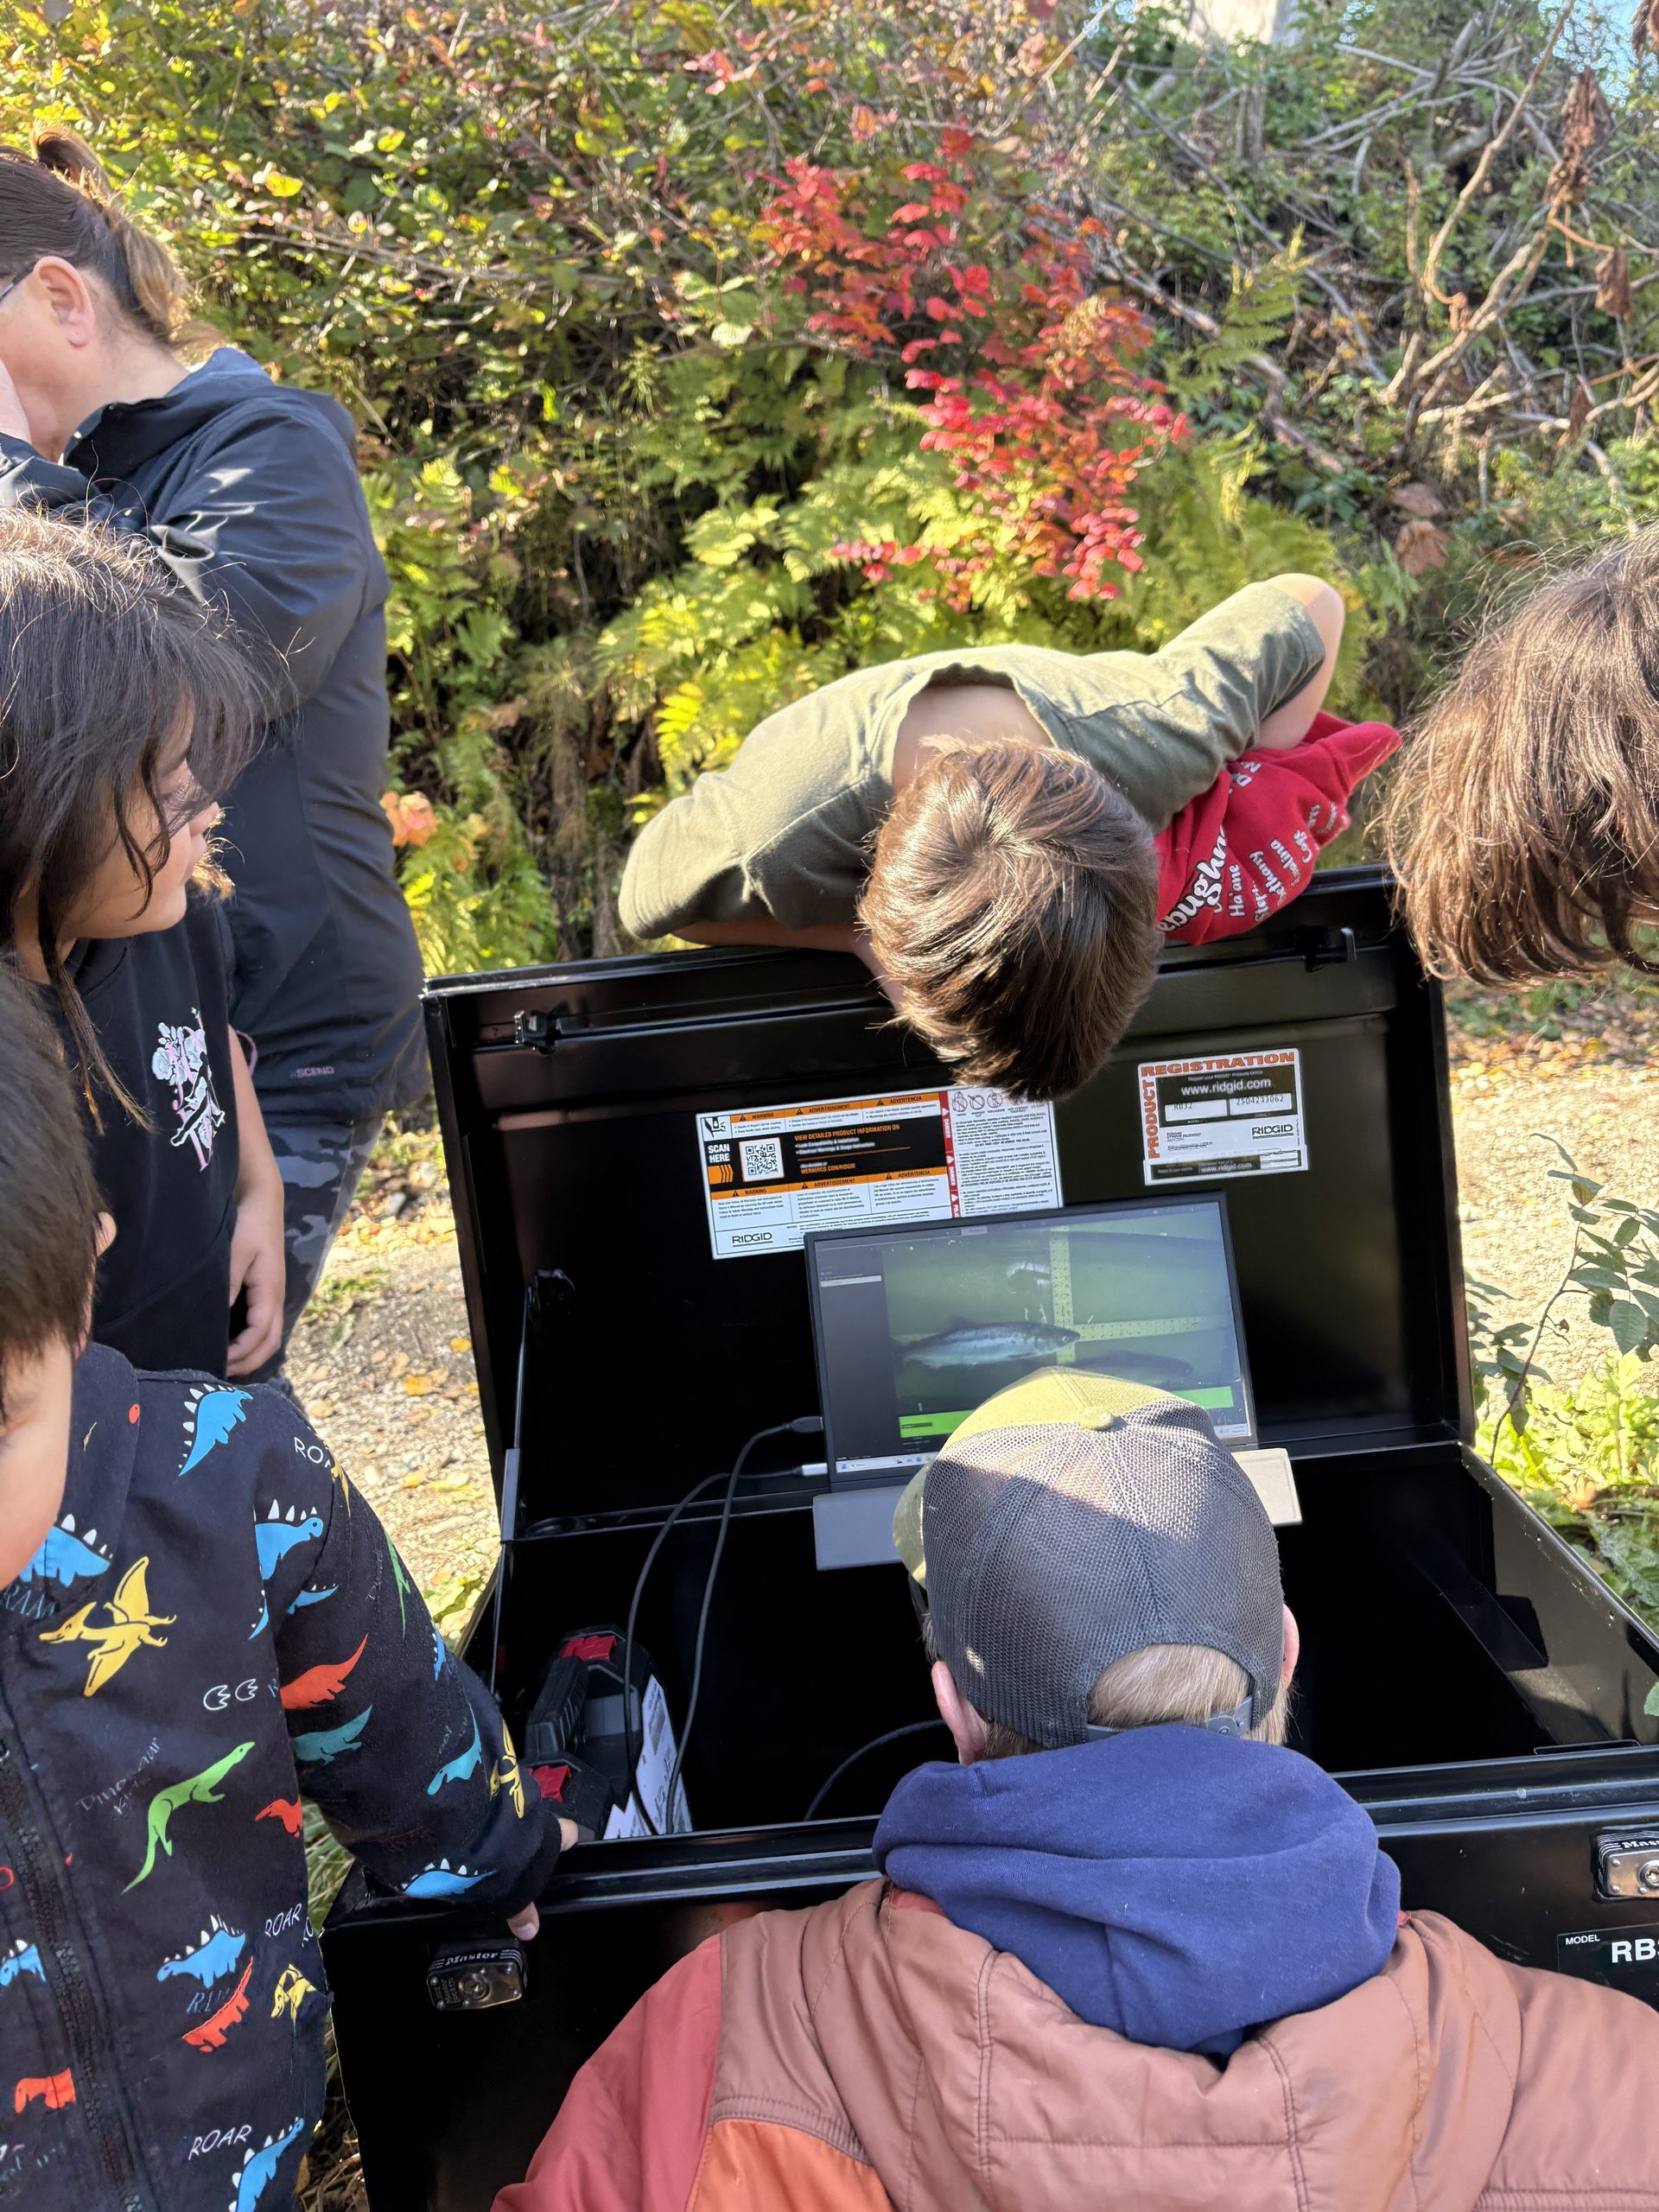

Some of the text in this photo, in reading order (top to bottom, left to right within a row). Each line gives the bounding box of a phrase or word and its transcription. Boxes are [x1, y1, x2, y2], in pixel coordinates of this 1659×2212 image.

[1141, 1052, 1295, 1077] REGISTRATION
[1181, 1077, 1271, 1096] www.ridgid.com
[1141, 1079, 1161, 1160] PRODUCT
[808, 1131, 831, 1140] DETAILED
[832, 1128, 856, 1137] PRODUCT
[857, 1125, 891, 1135] INFORMATION
[1252, 1123, 1294, 1135] RIDGID
[708, 1143, 730, 1154] SCAN
[709, 1153, 731, 1164] HERE
[898, 1169, 931, 1179] ADVERTENCIA
[732, 1231, 772, 1244] RIDGID
[1565, 1934, 1659, 1963] MODEL RB
[445, 1953, 499, 1966] Master
[188, 2124, 252, 2161] ROAR
